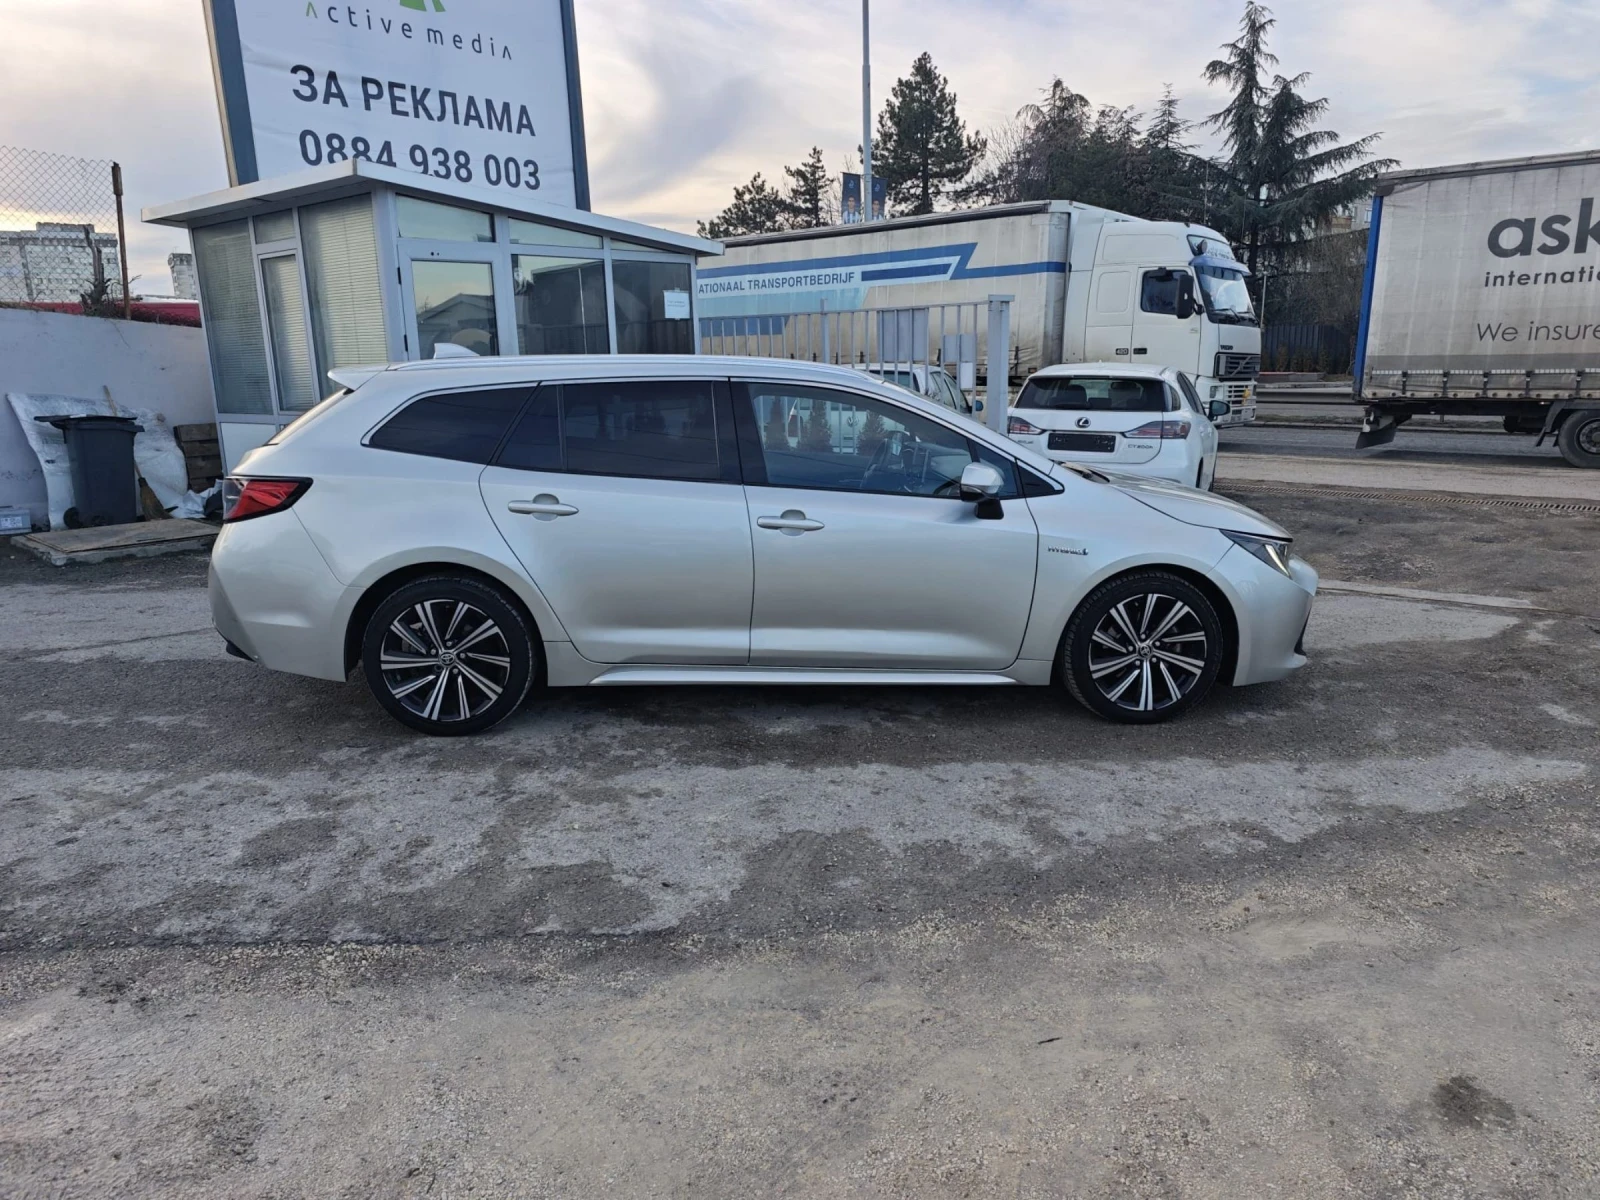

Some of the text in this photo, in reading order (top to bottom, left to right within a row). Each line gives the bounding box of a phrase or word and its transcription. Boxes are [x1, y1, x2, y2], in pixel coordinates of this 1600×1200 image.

[290, 64, 536, 137] ЗА РЕКЛАМА
[409, 144, 473, 183] 938
[484, 154, 541, 190] 003
[748, 271, 855, 290] TRANSPORTBEDRIJF
[1484, 266, 1600, 287] internati
[1477, 323, 1518, 342] We
